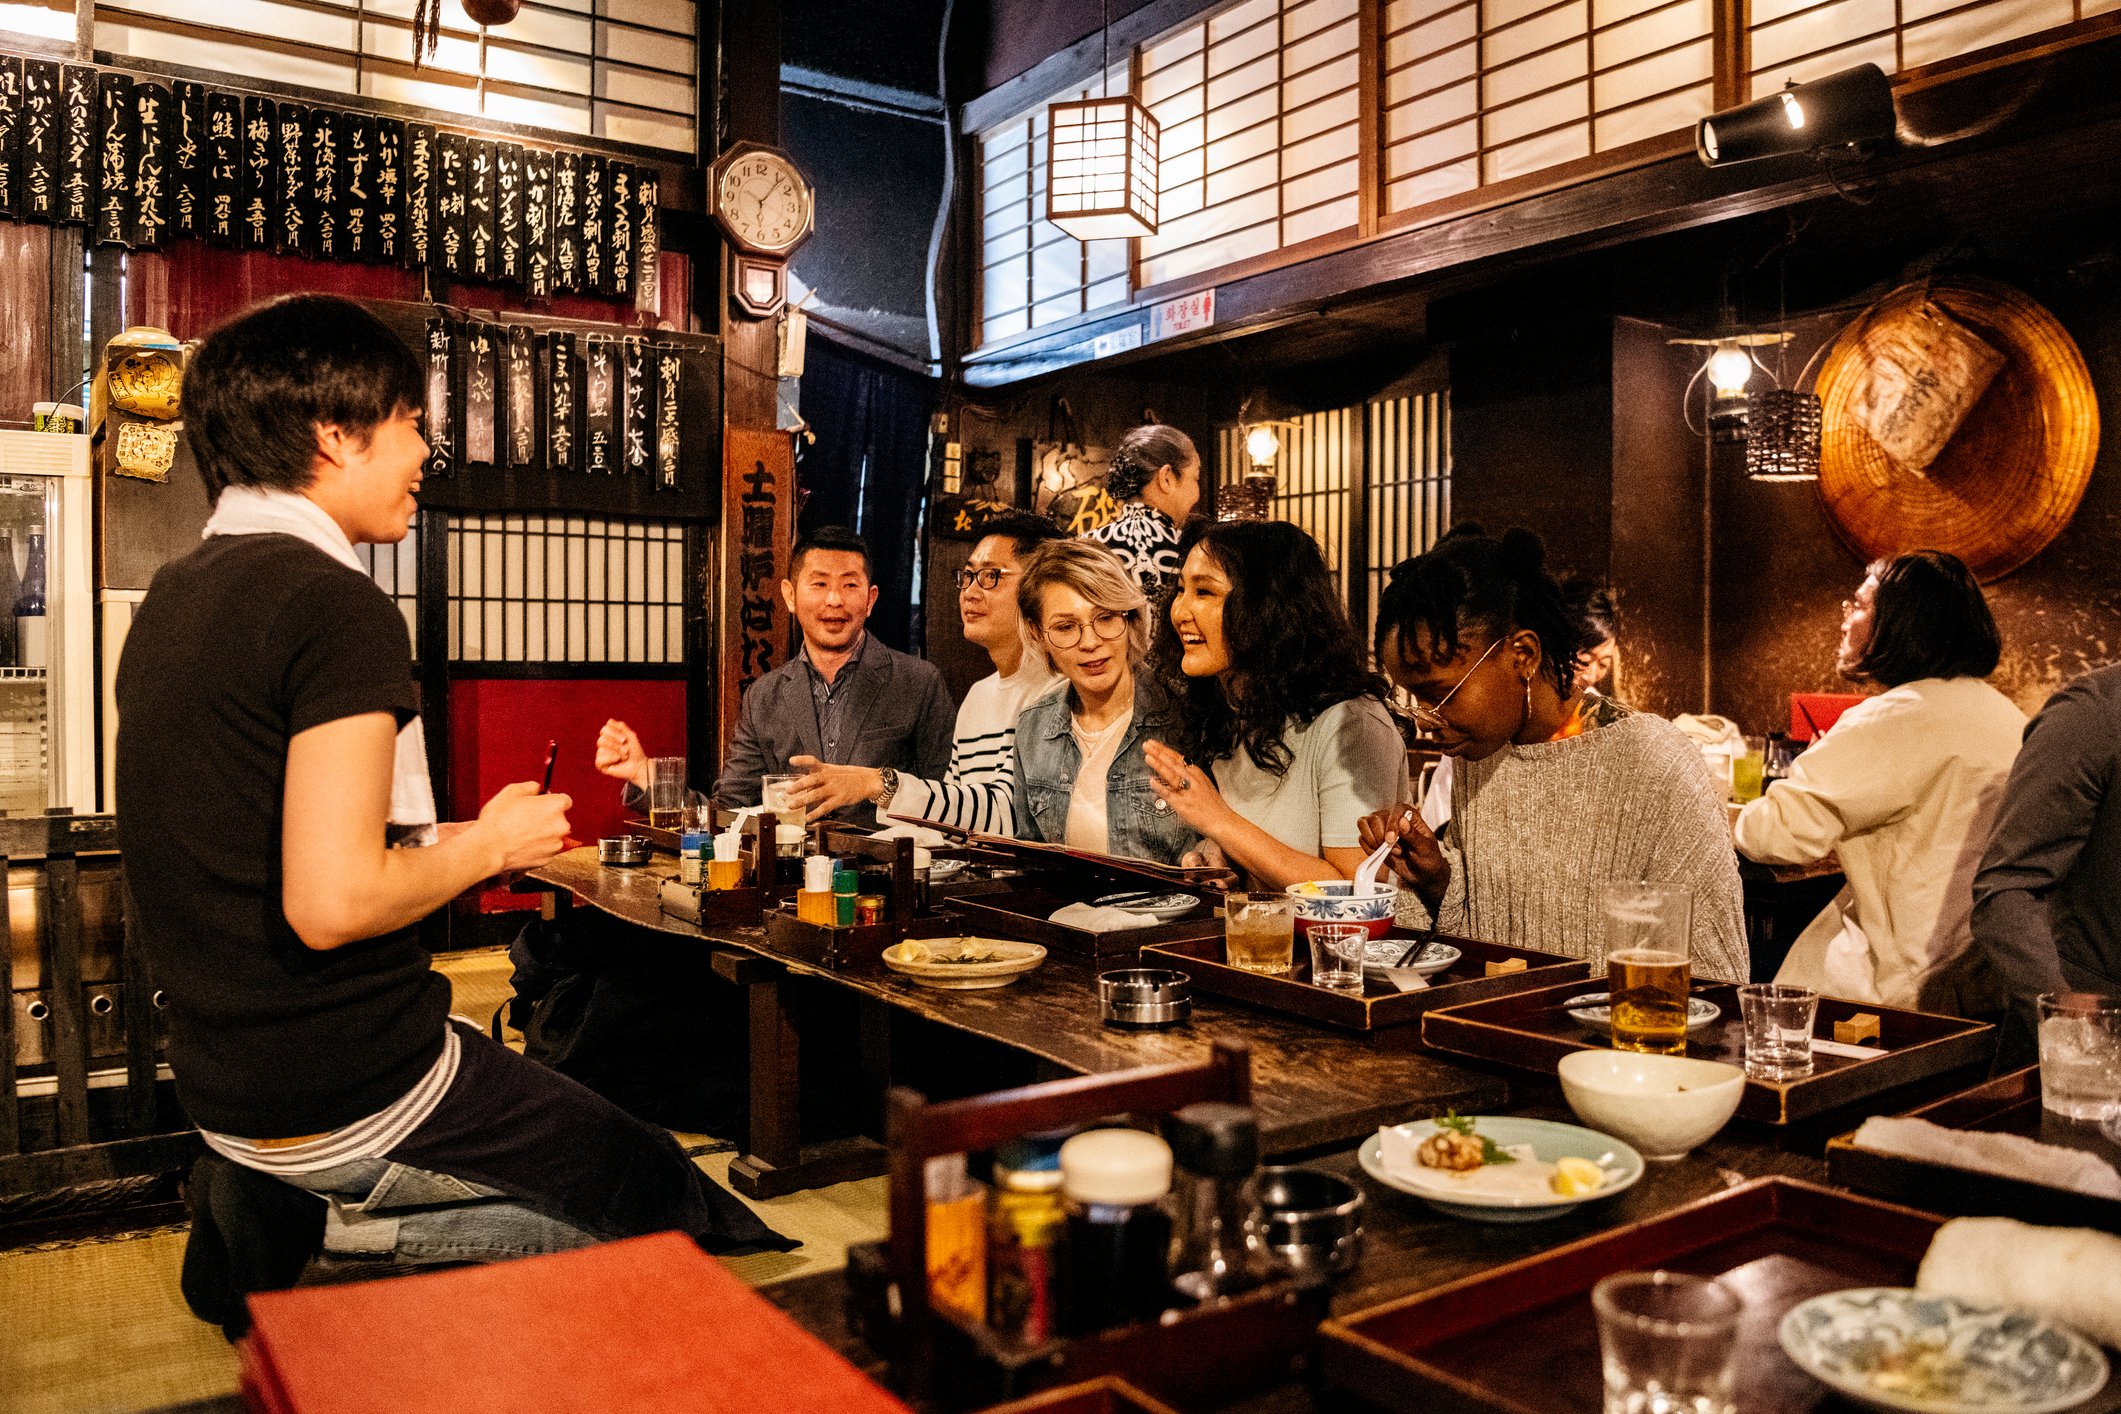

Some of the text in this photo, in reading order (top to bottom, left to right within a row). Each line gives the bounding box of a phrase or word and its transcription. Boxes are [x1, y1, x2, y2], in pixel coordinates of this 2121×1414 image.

[27, 75, 52, 153] いかバター
[68, 78, 90, 169] えのきバター
[742, 166, 751, 178] 11
[756, 163, 768, 176] 12
[729, 174, 741, 188] 10
[726, 190, 735, 202] 9
[783, 185, 793, 196] 2
[786, 202, 796, 213] 3
[730, 208, 739, 221] 8
[740, 222, 750, 234] 7
[783, 218, 792, 229] 4
[756, 229, 766, 241] 6
[772, 227, 781, 239] 5
[1165, 296, 1200, 321] 화장실
